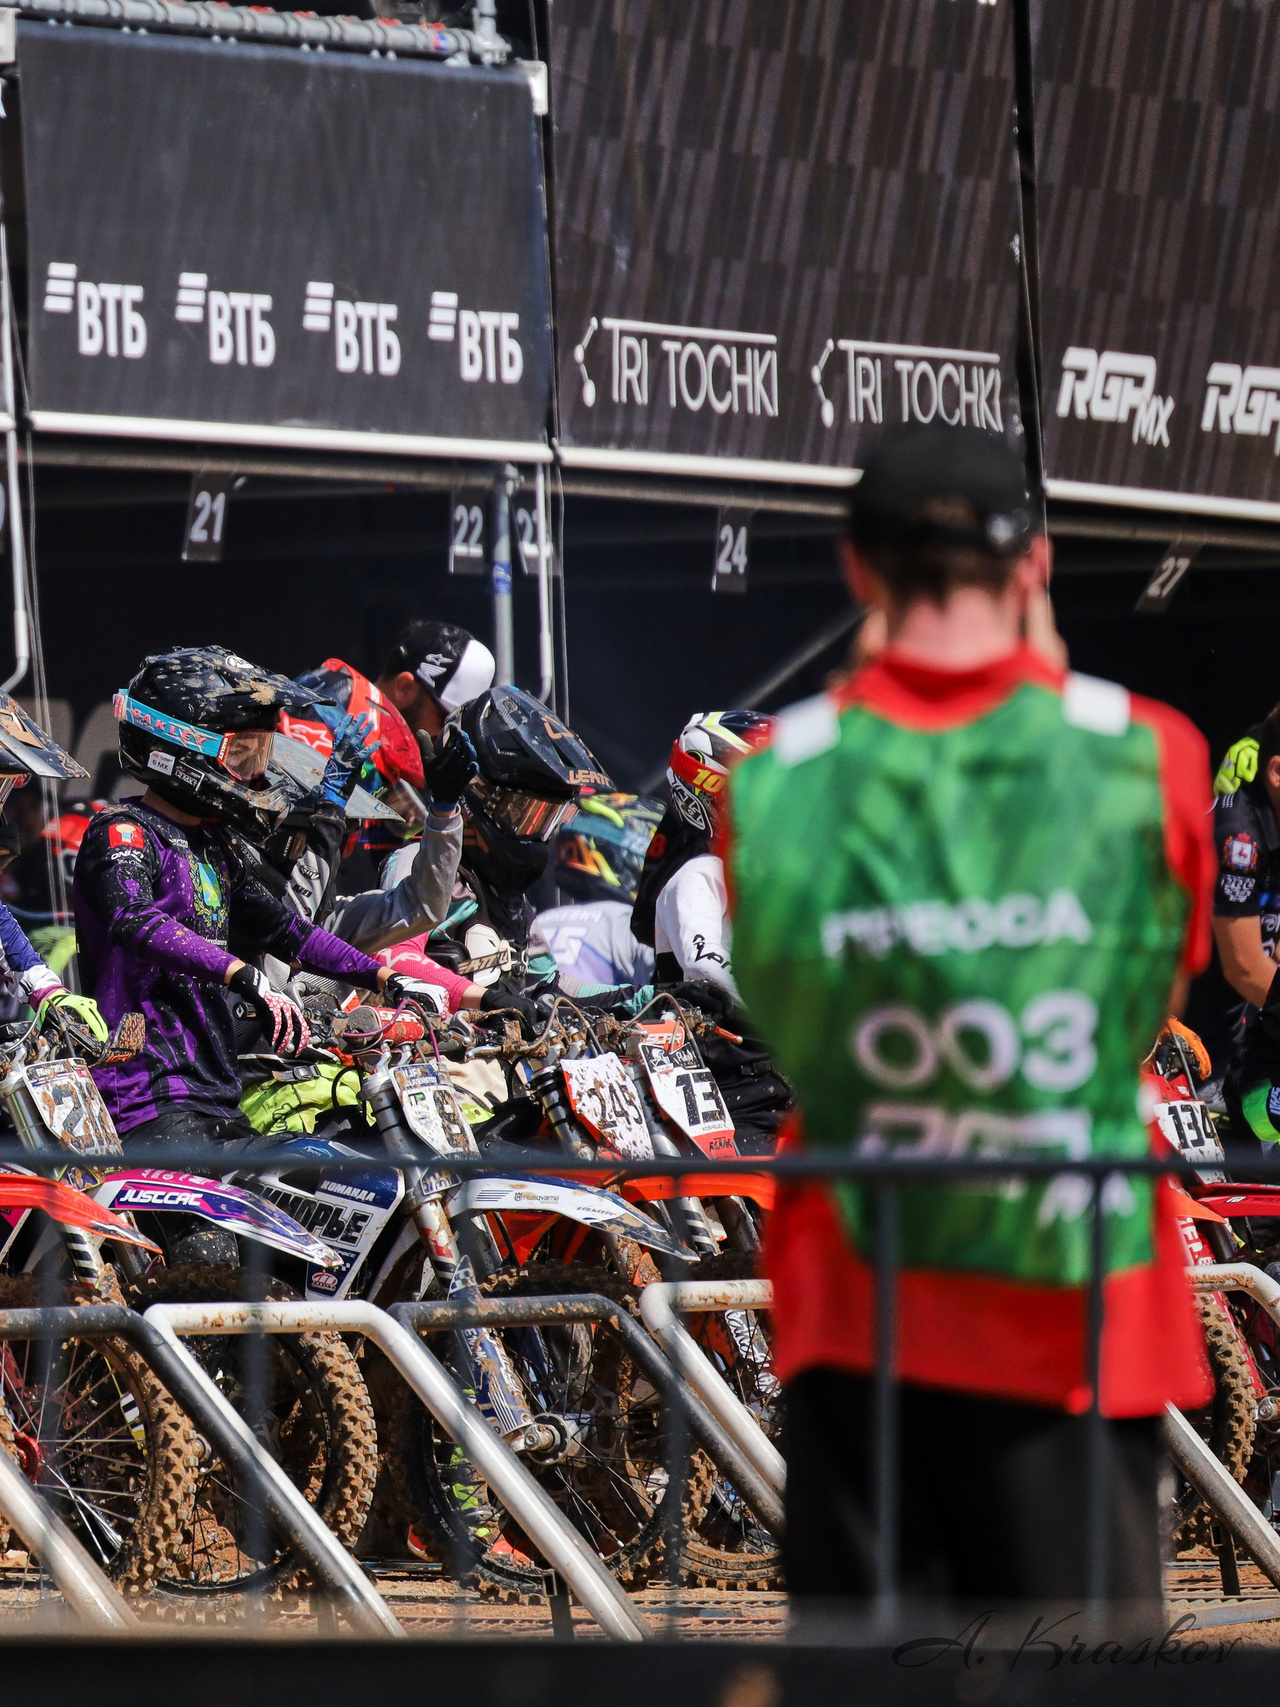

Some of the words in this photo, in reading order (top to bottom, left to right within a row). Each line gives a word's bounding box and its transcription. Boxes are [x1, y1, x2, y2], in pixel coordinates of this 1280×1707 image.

[77, 282, 147, 359] ВТБ
[208, 290, 275, 367] ВТБ
[334, 301, 401, 376] ВТБ
[458, 310, 523, 384] ВТБ
[602, 317, 649, 406] TRI
[662, 338, 779, 417] TOCHKI
[837, 338, 882, 424] TRI
[895, 358, 1005, 433] TOCHKI
[190, 491, 225, 543] 21
[453, 503, 484, 557] 22
[718, 525, 748, 575] 24
[1147, 556, 1190, 599] 27
[131, 707, 208, 746] OAKLEY
[568, 769, 610, 787] LEATT
[692, 768, 724, 793] 10
[853, 989, 1098, 1094] 003
[320, 1179, 376, 1202] КОМАНДА
[322, 1411, 332, 1442] EXCEL
